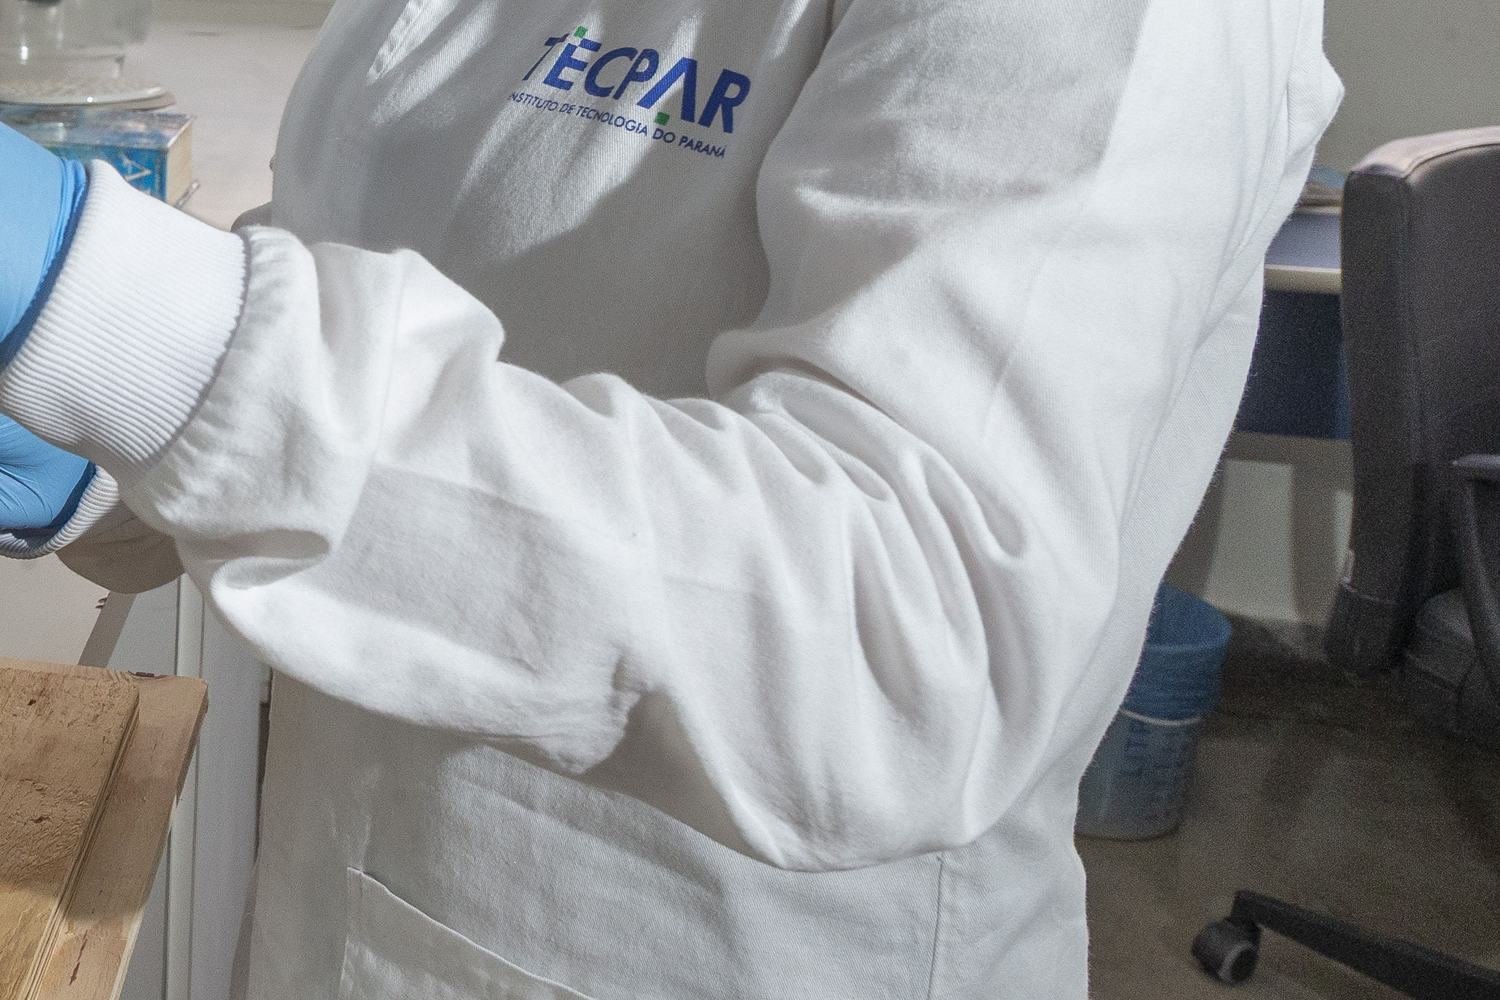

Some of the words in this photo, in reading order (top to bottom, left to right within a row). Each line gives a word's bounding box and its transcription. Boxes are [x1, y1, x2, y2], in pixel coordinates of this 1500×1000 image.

[508, 91, 558, 111] NSTITUTO
[559, 103, 577, 115] DE
[576, 105, 649, 137] TECNOLOGIA
[651, 127, 676, 144] DO
[522, 29, 751, 134] TECPAR
